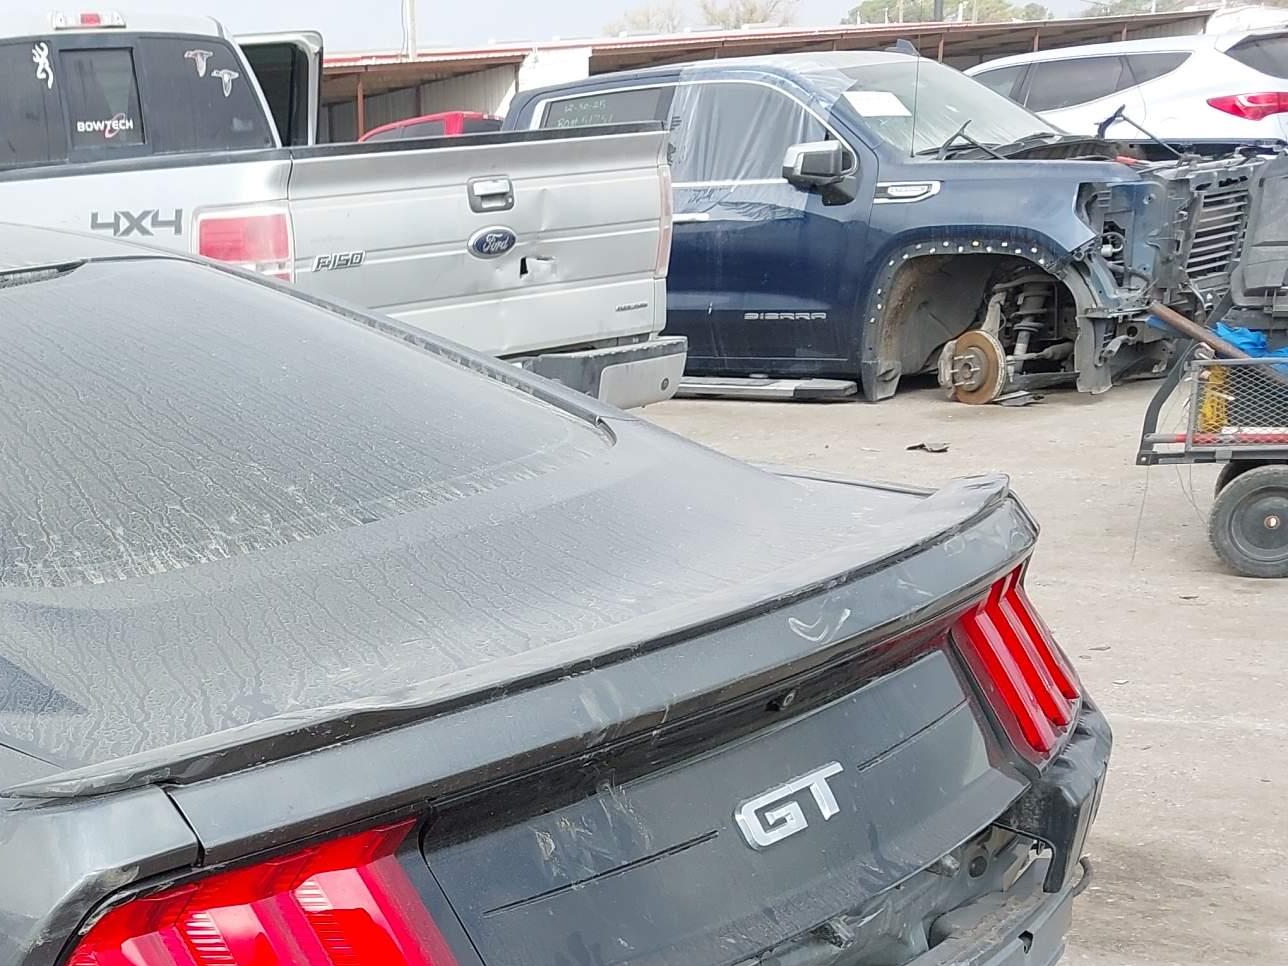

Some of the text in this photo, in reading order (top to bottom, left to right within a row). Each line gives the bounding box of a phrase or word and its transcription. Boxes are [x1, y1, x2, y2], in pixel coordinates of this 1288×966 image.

[77, 118, 134, 132] BOWTECH
[482, 233, 510, 252] Ford
[312, 250, 366, 272] F-150
[743, 312, 828, 321] SIERRA
[733, 760, 845, 851] GT
